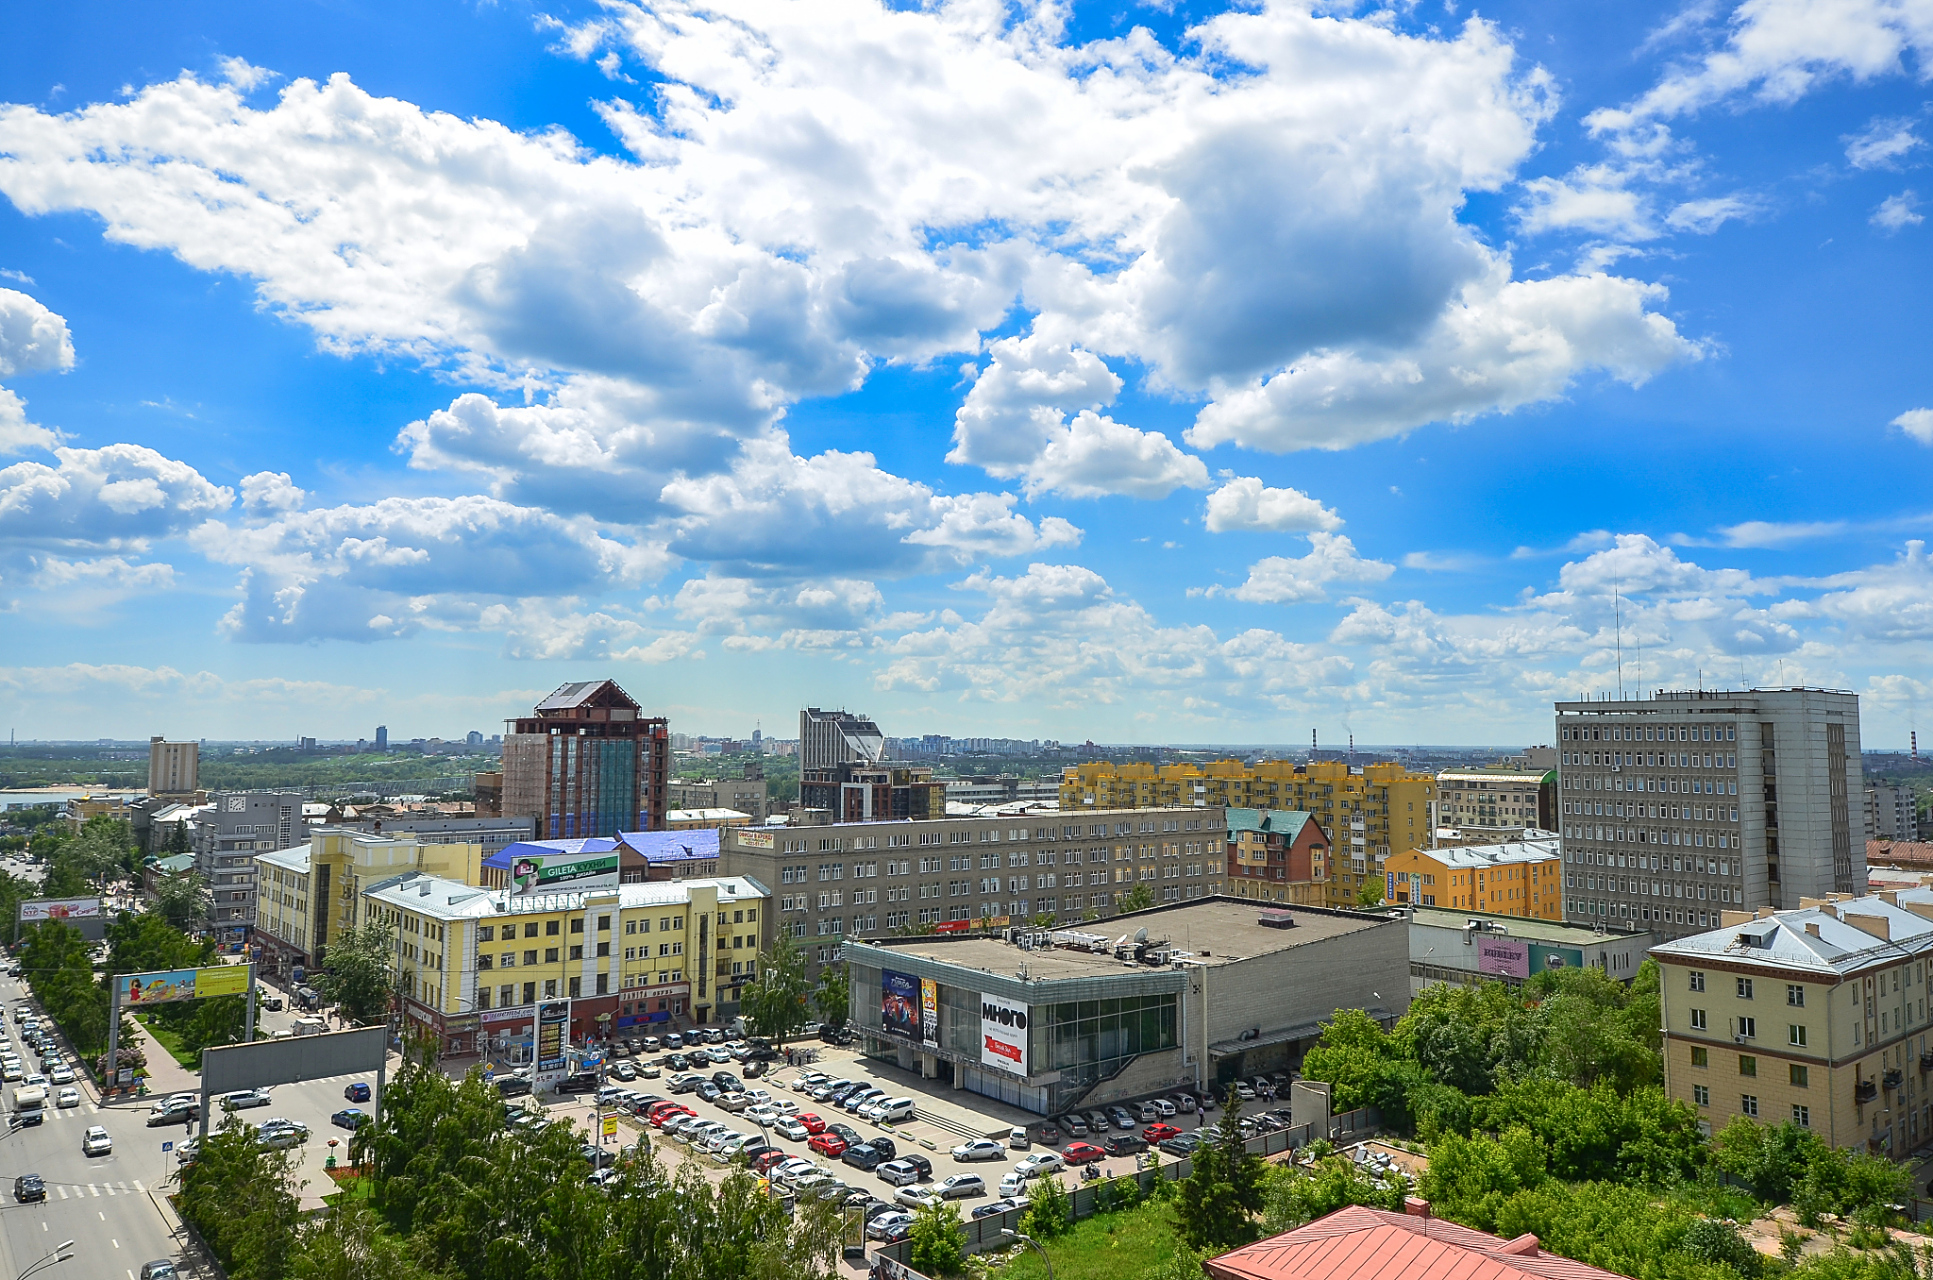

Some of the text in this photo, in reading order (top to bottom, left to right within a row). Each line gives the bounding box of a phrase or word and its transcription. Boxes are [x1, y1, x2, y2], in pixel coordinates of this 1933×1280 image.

[547, 860, 606, 877] GILETA КУХНИ
[575, 870, 596, 879] ДИЗАЙН
[623, 988, 673, 1000] JANITA ОБУВЬ
[982, 1002, 1027, 1030] МНОГО
